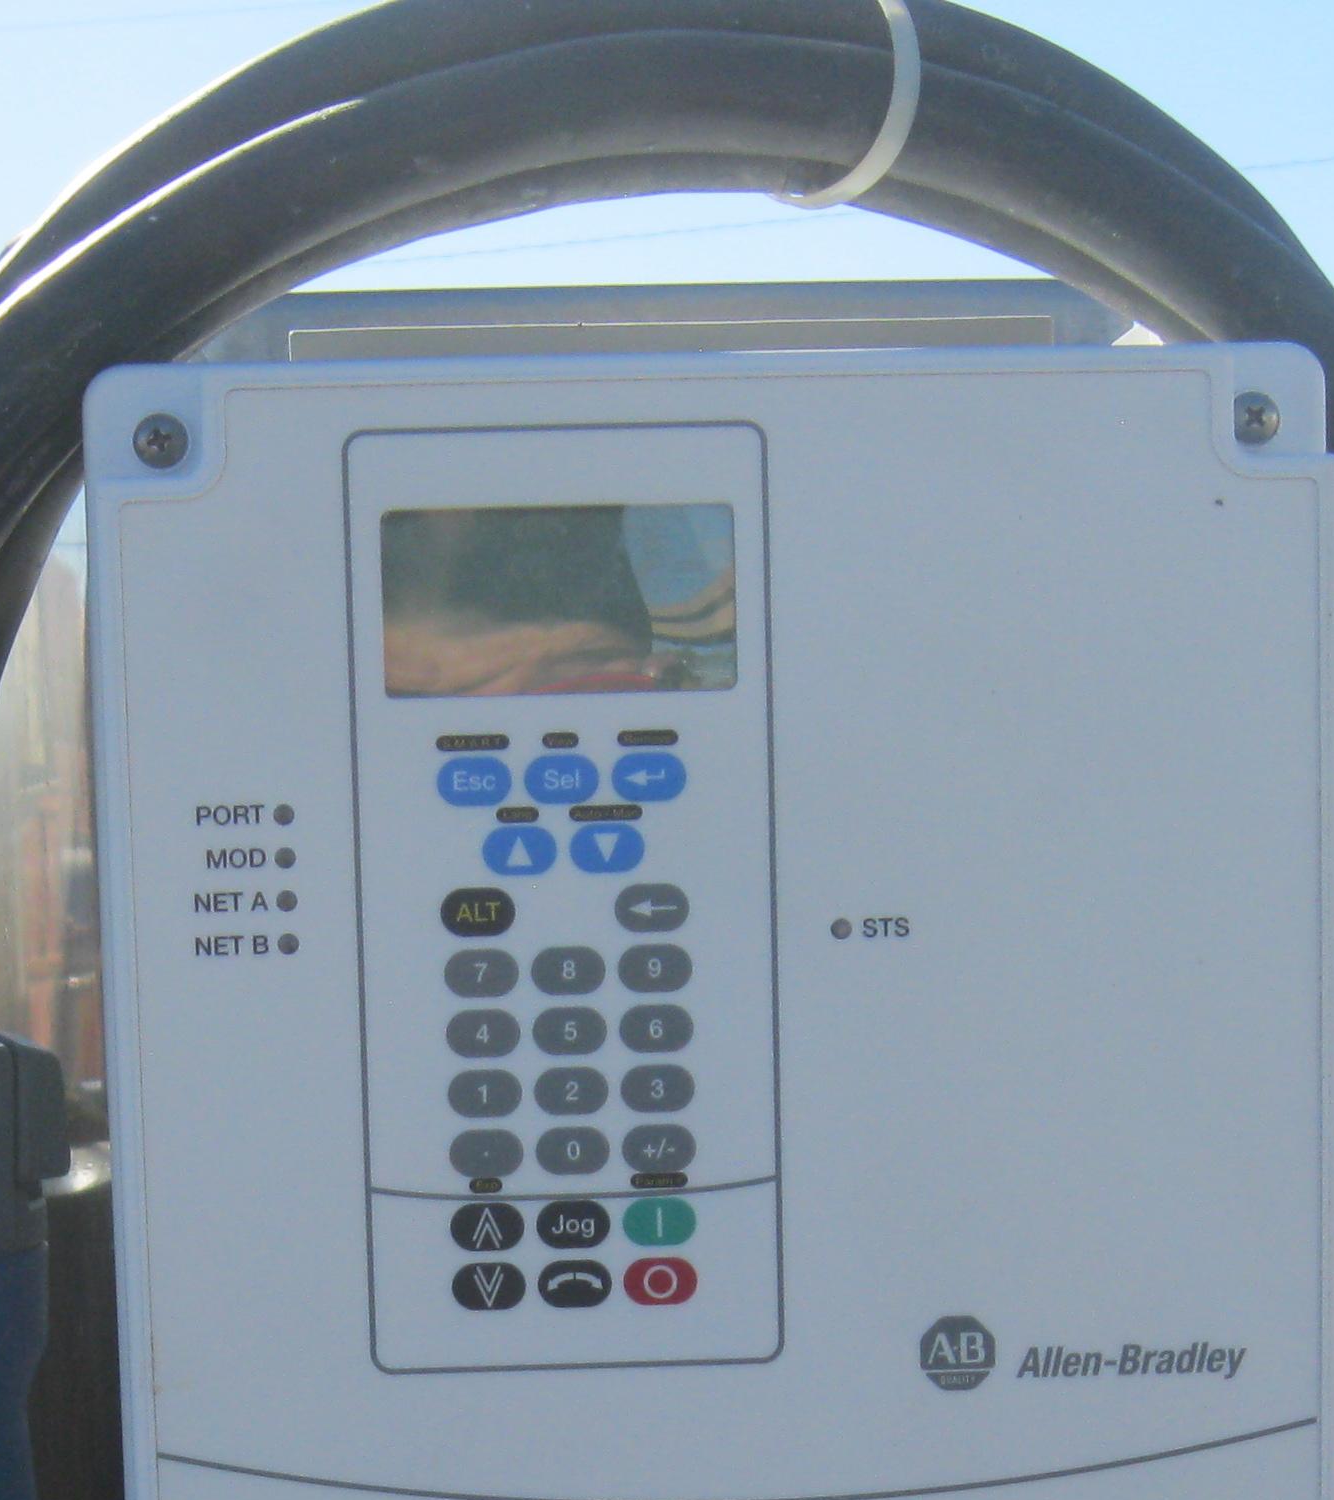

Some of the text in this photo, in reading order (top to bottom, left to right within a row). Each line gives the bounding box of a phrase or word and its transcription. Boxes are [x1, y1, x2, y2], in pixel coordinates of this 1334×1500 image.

[452, 769, 496, 792] Esc
[543, 768, 581, 791] Sel
[195, 804, 265, 826] PORT
[205, 848, 267, 869] MOD
[193, 891, 269, 913] NET A
[455, 901, 501, 923] ALT
[862, 917, 910, 938] STS
[194, 935, 270, 956] NET B
[473, 958, 662, 983] 7 8 9
[475, 1018, 663, 1044] 4 5 6
[477, 1078, 664, 1104] 1 2 3
[567, 1140, 580, 1161] 0
[551, 1214, 596, 1238] Jog
[1016, 1342, 1248, 1380] Allen-Bradley
